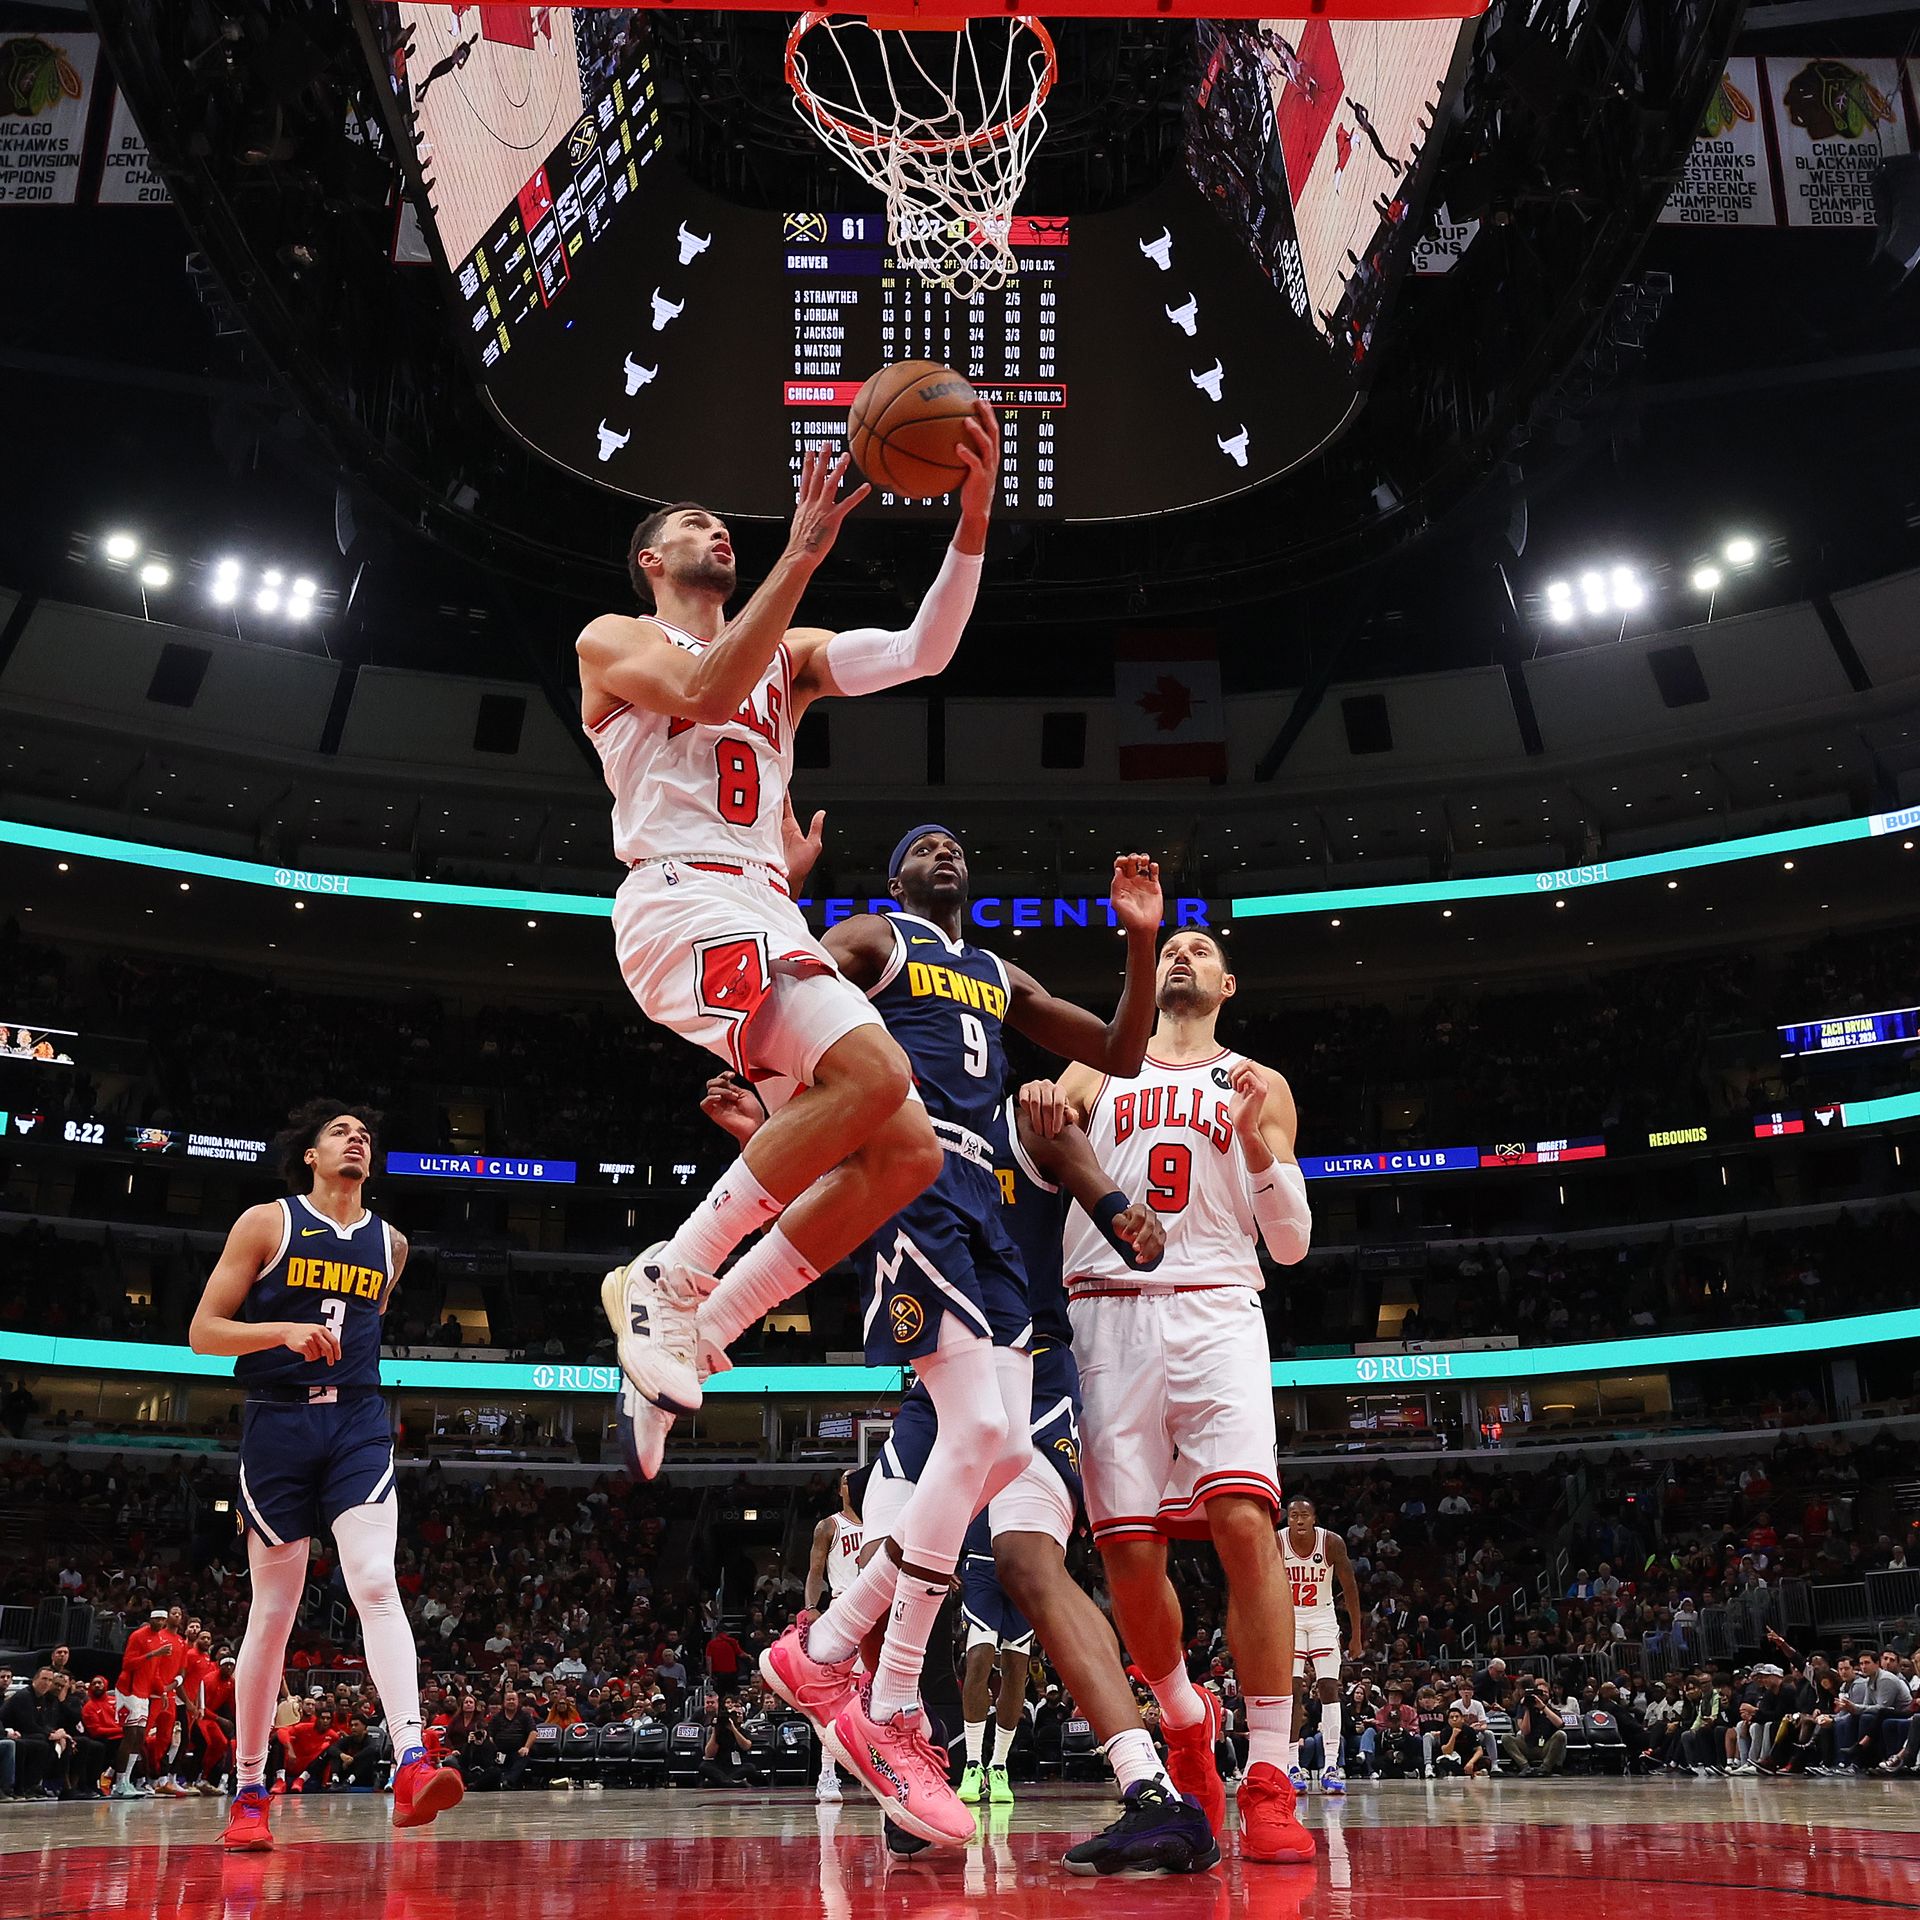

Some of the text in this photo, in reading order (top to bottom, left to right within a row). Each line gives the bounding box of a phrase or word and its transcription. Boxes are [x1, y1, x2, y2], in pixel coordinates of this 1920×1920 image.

[1812, 143, 1878, 156] CHICAGO
[18, 154, 80, 167] DIVISION
[580, 163, 602, 198] 61
[555, 183, 581, 234] 8:27
[1665, 195, 1752, 209] CHAMPIONS
[1680, 209, 1738, 222] 2012-13
[842, 218, 864, 240] 61
[787, 255, 828, 269] DENVER
[944, 260, 960, 270] 3PT:
[882, 278, 896, 288] MIN
[906, 278, 911, 288] F
[1006, 279, 1020, 288] 3PT
[1043, 279, 1053, 289] FT
[508, 284, 522, 300] 1
[794, 290, 801, 304] 3
[803, 290, 858, 304] STRAWTHER
[883, 291, 893, 304] 11
[904, 291, 912, 304] 2
[924, 291, 931, 304] 8
[944, 291, 950, 304] 0
[1005, 292, 1020, 306] 2/5
[1039, 292, 1056, 306] 0/0
[794, 308, 1056, 324] 6 JORDAN 03 0 0 1 0/0 0/0 0/0
[794, 326, 1056, 342] 7 JACKSON 09 0 9 0 3/4 3/3 0/0
[794, 344, 1056, 360] 8 WATSON 12 2 2 3 1/3 0/0 0/0
[794, 362, 1056, 378] 9 HOLIDAY 2/4 2/4 0/0
[788, 387, 834, 401] CHICAGO
[1005, 391, 1017, 401] FT:
[1018, 391, 1032, 403] 6/6
[1004, 410, 1051, 420] 3PT FT
[791, 421, 1054, 437] 12 DOSUNMU 0/1 0/0
[795, 439, 1054, 455] 9 0/1 0/0
[788, 457, 801, 470] 44
[1003, 458, 1017, 472] 0/1
[1038, 459, 1053, 472] 0/0
[1003, 476, 1018, 489] 0/3
[1038, 476, 1053, 490] 6/6
[881, 492, 894, 505] 20
[943, 492, 949, 506] 3
[1005, 493, 1018, 507] 1/4
[1038, 493, 1053, 507] 0/0
[714, 736, 760, 828] 8
[292, 871, 350, 894] RUSH
[1554, 863, 1608, 888] RUSH
[971, 897, 1211, 928] CENTR
[907, 962, 1006, 1020] DENVER
[1821, 1018, 1873, 1037] ZACH BRYAN
[959, 1013, 989, 1079] 9
[1114, 1085, 1234, 1155] BULLS
[1771, 1112, 1782, 1123] 15
[63, 1120, 104, 1145] 8:22
[1648, 1127, 1708, 1147] REBOUNDS
[1772, 1124, 1784, 1134] 32
[188, 1133, 266, 1152] FLORIDA PANTHERS
[187, 1145, 258, 1162] MINNESOTA WILD
[1537, 1151, 1559, 1163] BULLS
[419, 1157, 544, 1177] ULTRA CLUB
[599, 1163, 696, 1174] TIMEOUTS FOULS
[1324, 1153, 1446, 1172] ULTRA CLUB
[612, 1173, 687, 1184] 5 2
[1146, 1142, 1192, 1214] 9
[287, 1257, 384, 1301] DENVER
[320, 1298, 347, 1343] 3
[1381, 1354, 1453, 1379] RUSH
[1291, 1582, 1317, 1607] 12
